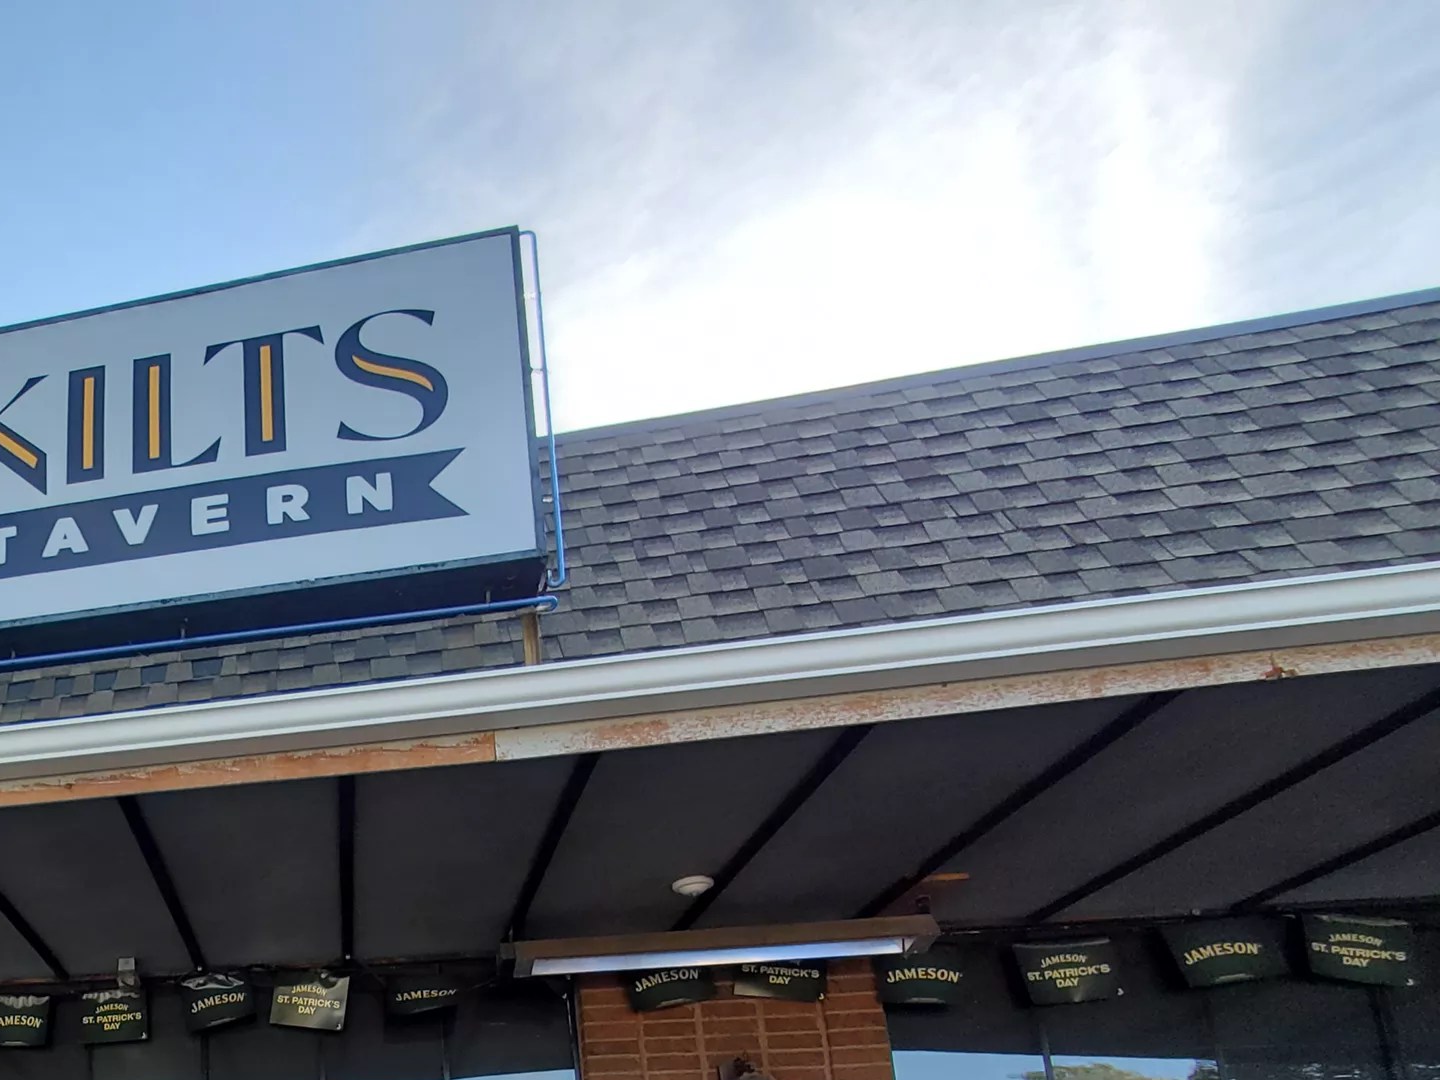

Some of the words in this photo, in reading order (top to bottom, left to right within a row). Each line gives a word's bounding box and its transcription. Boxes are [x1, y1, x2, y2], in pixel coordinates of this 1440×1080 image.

[1328, 933, 1383, 947] JAMESON
[1184, 942, 1261, 965] JAMESON
[1311, 942, 1329, 954] ST.
[1330, 946, 1408, 962] PATRICK'S
[1040, 954, 1088, 968] JAMESON
[1342, 957, 1371, 968] DAY
[741, 964, 759, 974] ST.
[760, 965, 820, 979] PATRICK'S
[886, 967, 961, 983] JAMESON
[1027, 971, 1043, 982] ST.
[1044, 963, 1111, 981] PATRICK'S
[635, 968, 700, 993] JAMESON
[768, 976, 791, 985] DAY
[1056, 978, 1080, 989] DAY
[291, 984, 328, 996] JAMESON
[395, 989, 457, 1001] JAMESON
[95, 1003, 129, 1014] JAMESON
[191, 992, 246, 1013] JAMESON
[277, 995, 291, 1005] ST.
[292, 996, 341, 1010] PATRICK'S
[297, 1005, 316, 1016] DAY
[82, 1016, 96, 1025] ST.
[96, 1012, 142, 1024] PATRICK'S
[103, 1022, 121, 1031] DAY
